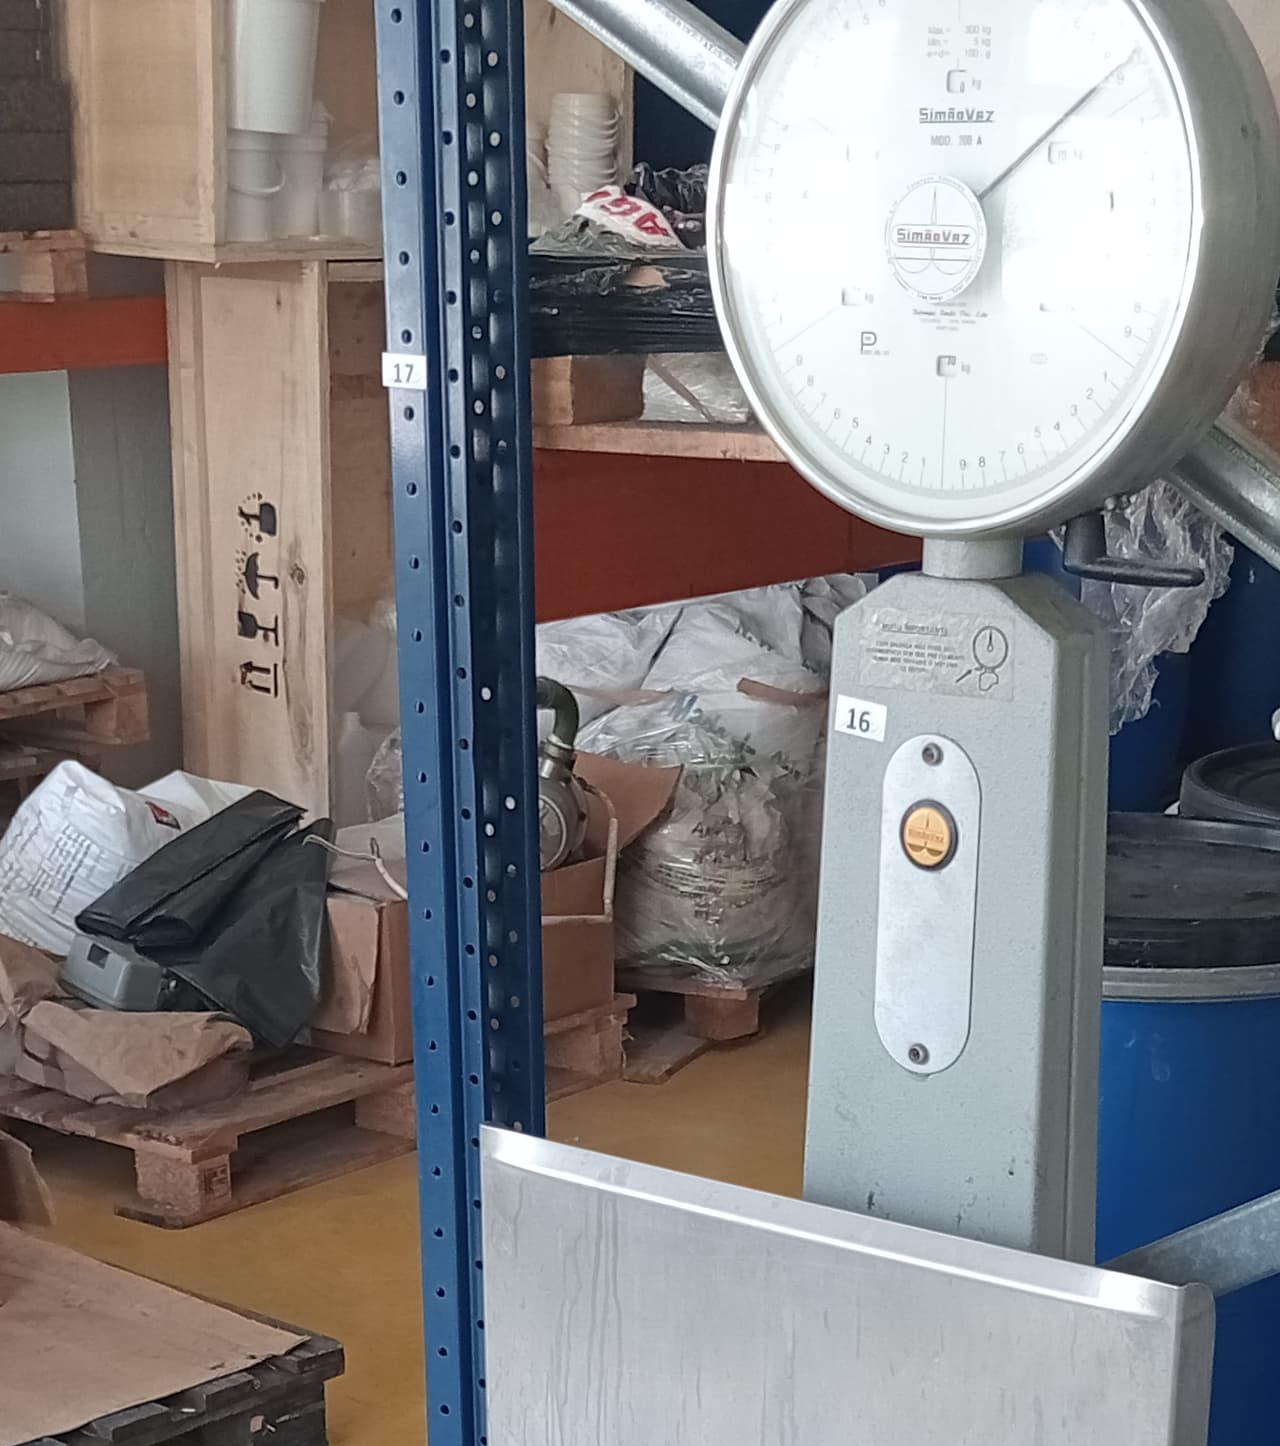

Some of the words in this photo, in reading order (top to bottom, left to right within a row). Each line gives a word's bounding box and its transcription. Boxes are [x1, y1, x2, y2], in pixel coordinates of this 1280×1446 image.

[393, 362, 414, 384] 17
[883, 444, 890, 455] 3
[1017, 442, 1024, 455] 6
[901, 451, 909, 463] 2
[978, 456, 986, 469] 8
[960, 459, 967, 471] 9
[846, 708, 870, 733] 16
